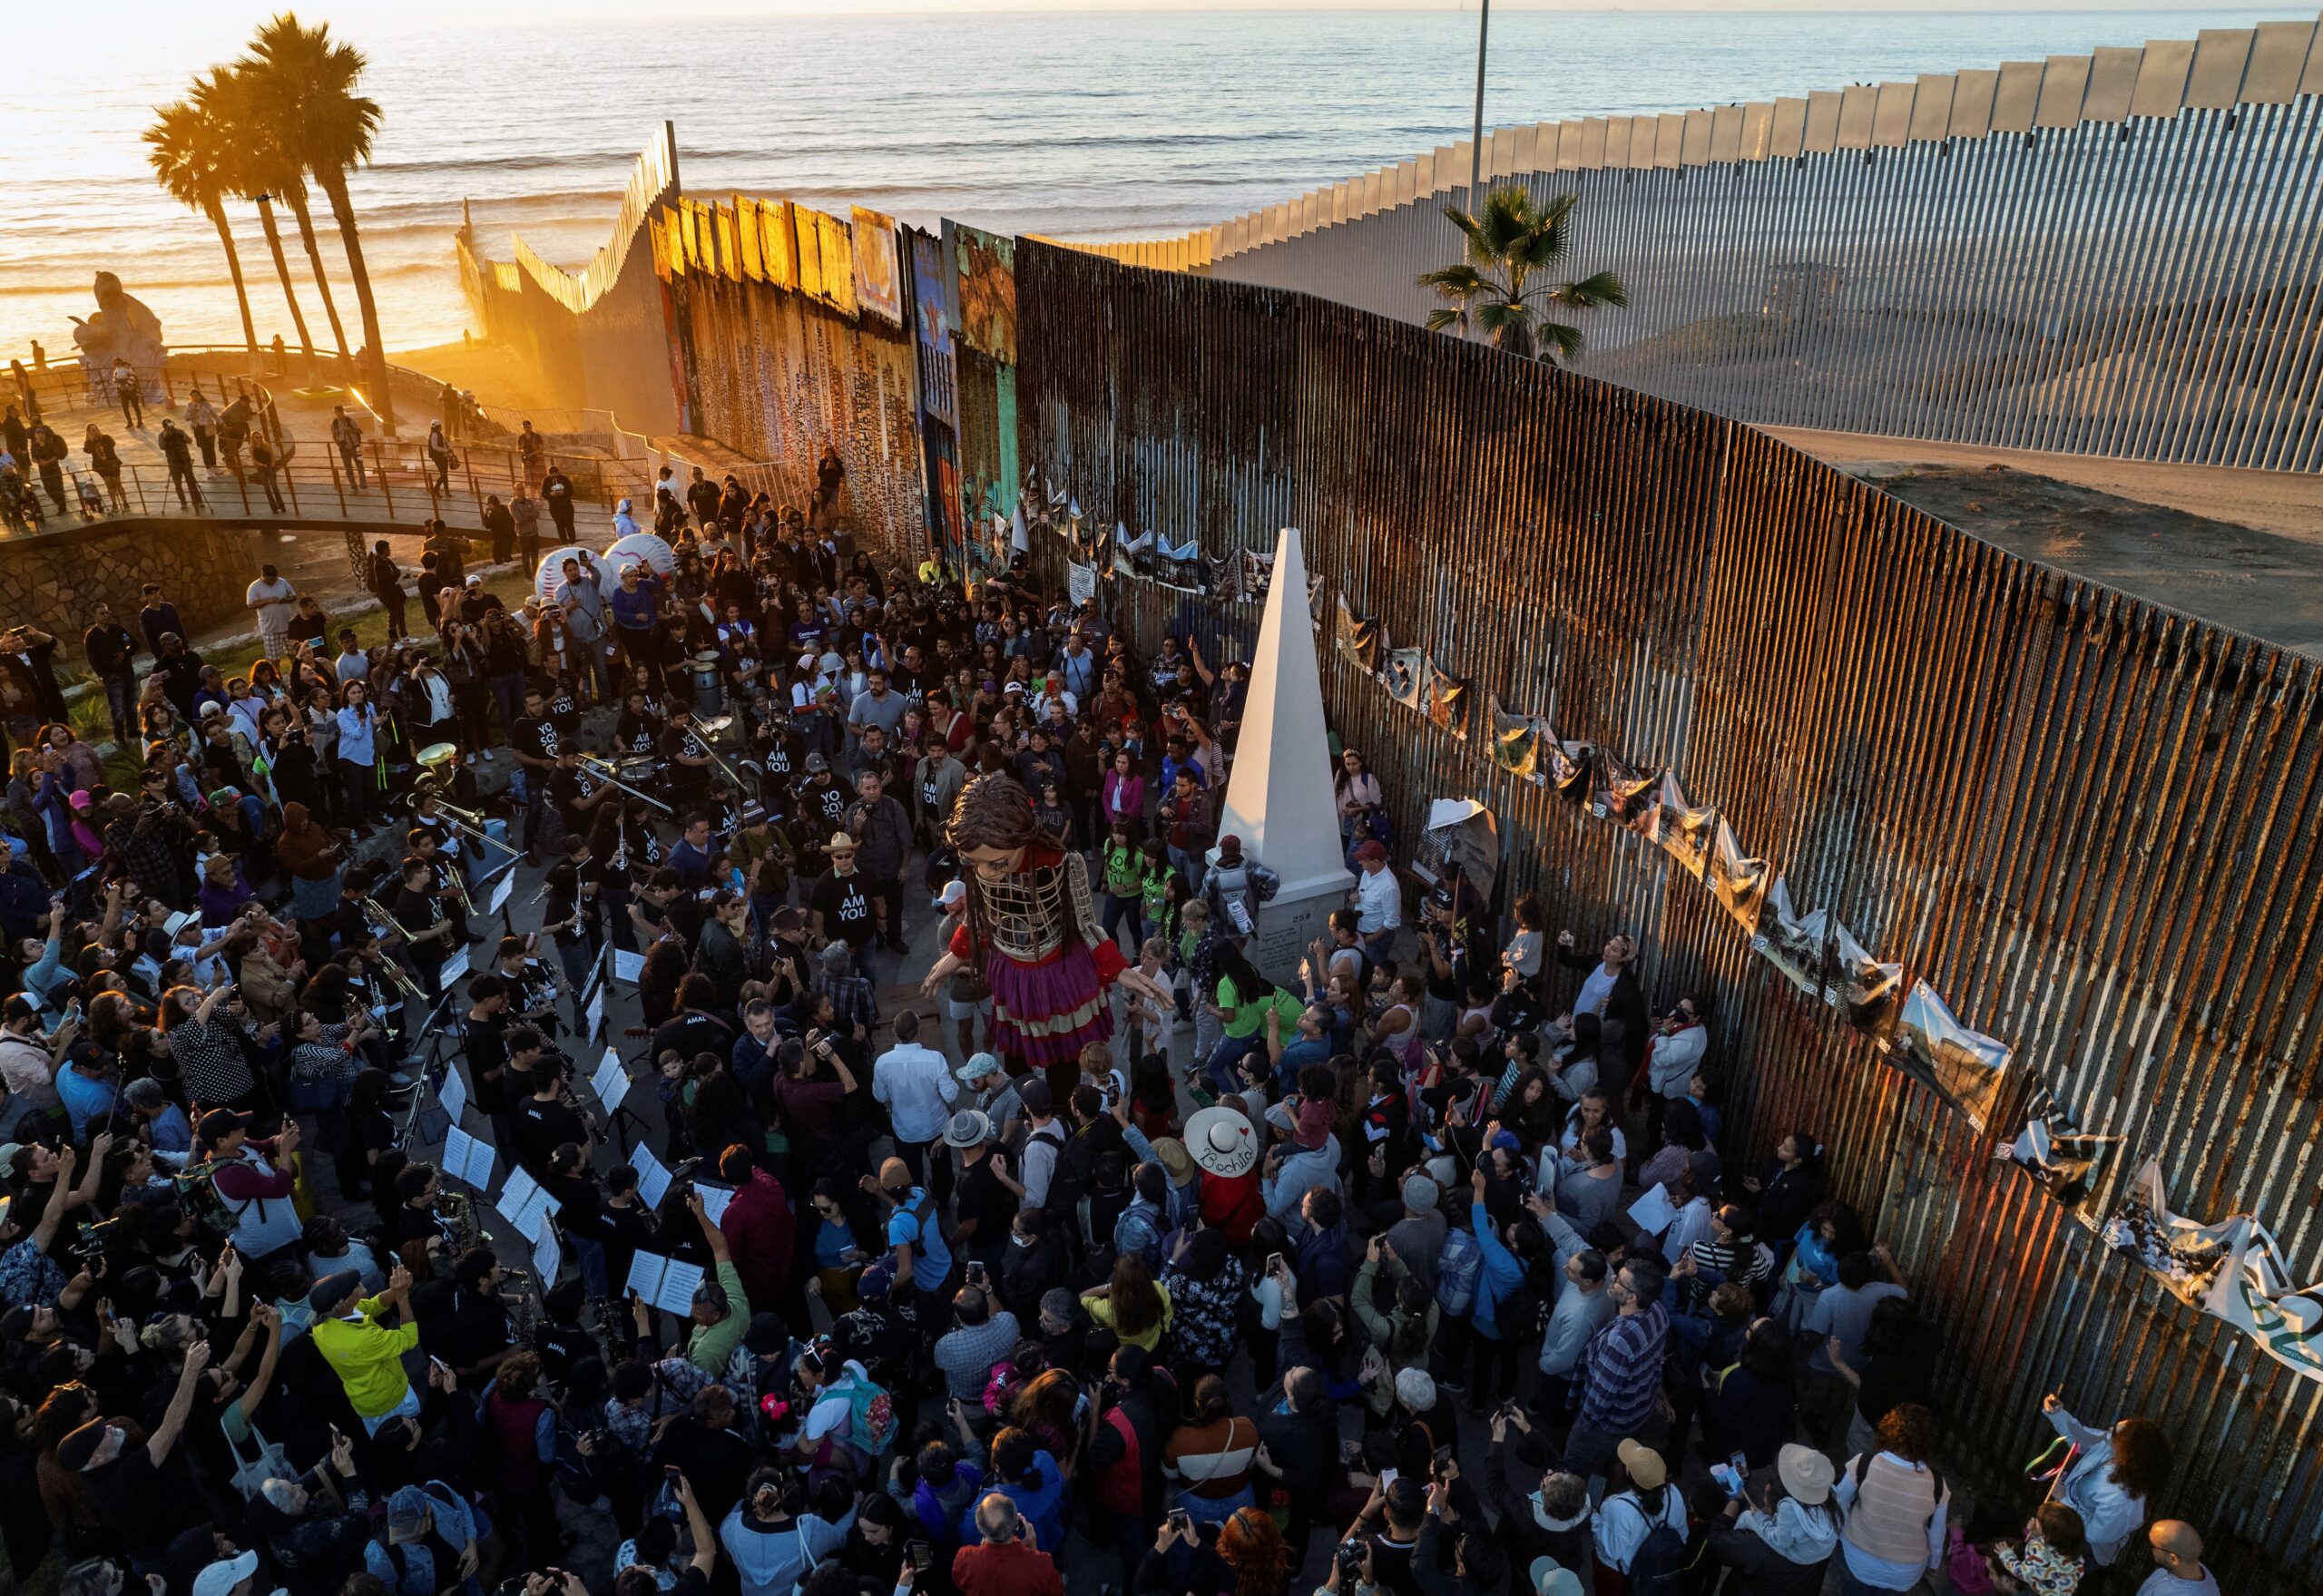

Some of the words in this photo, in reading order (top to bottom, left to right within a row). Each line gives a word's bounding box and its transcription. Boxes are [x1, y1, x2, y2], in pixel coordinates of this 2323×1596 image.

[854, 377, 863, 414] PEREZ
[856, 417, 865, 455] FELIPE
[915, 514, 926, 553] MURILLO
[645, 694, 651, 704] I
[552, 700, 574, 714] YOU
[537, 722, 553, 736] YO
[640, 722, 643, 731] I
[540, 730, 558, 747] SOY
[636, 732, 650, 743] AM
[632, 740, 654, 752] YOU
[776, 740, 779, 751] I
[768, 751, 787, 761] AM
[766, 760, 790, 772] YOU
[574, 770, 586, 783] YO
[923, 782, 937, 795] AM
[820, 790, 840, 804] YO
[723, 805, 730, 815] I
[823, 798, 844, 815] SOY
[722, 813, 737, 827] AM
[643, 829, 650, 839] I
[646, 837, 657, 853] AM
[646, 849, 660, 863] YO
[436, 865, 444, 875] I
[848, 884, 854, 896] I
[842, 895, 865, 908] AM
[838, 904, 867, 921] YOU
[1292, 913, 1311, 923] 258
[1753, 936, 1767, 949] 52
[687, 1015, 708, 1025] AMAL
[527, 1109, 544, 1121] AMAL
[601, 1214, 617, 1228] AMAL
[547, 1341, 566, 1356] AMAL
